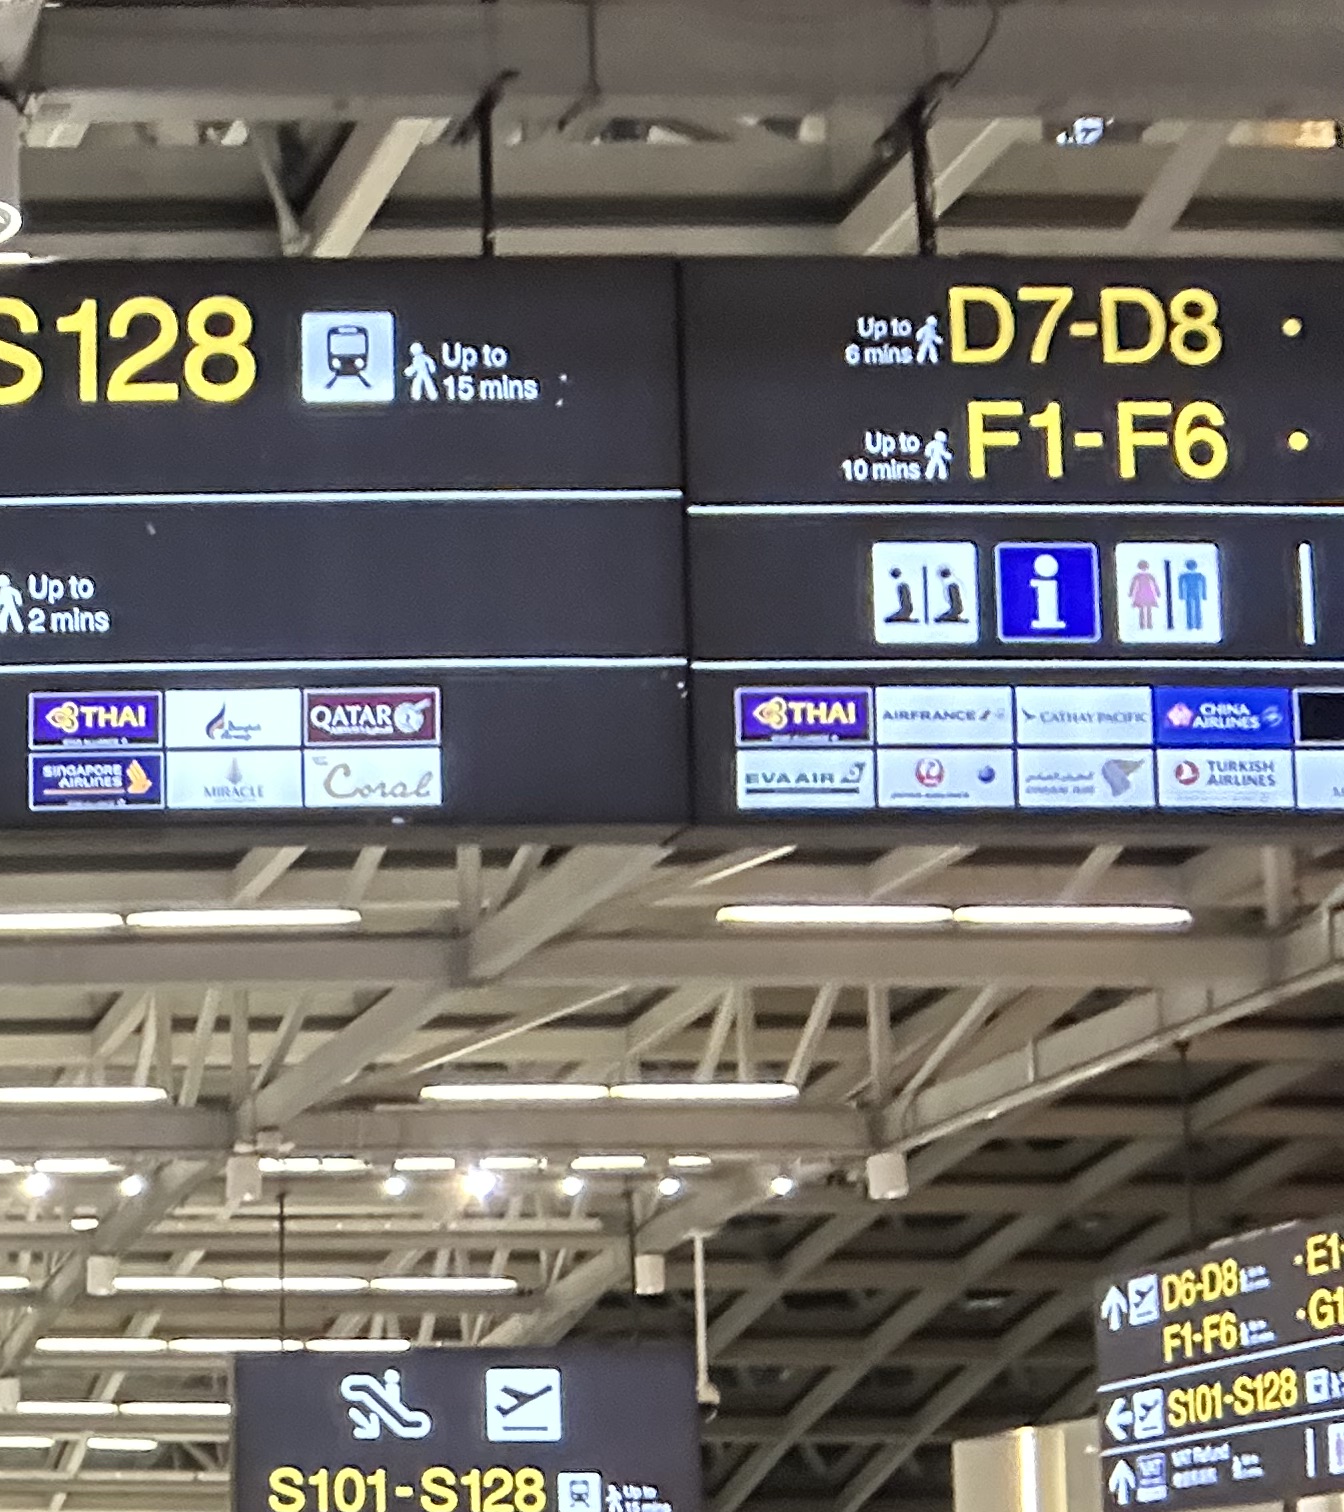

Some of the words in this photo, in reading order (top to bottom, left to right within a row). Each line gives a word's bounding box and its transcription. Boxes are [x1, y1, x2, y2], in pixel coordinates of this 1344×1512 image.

[857, 317, 888, 341] Up
[890, 318, 912, 337] to
[949, 286, 1222, 366] D7-D8
[442, 342, 478, 373] Up
[482, 345, 507, 368] to
[845, 343, 860, 365] 6
[864, 344, 913, 365] mins
[443, 375, 474, 401] 15
[478, 375, 538, 400] mins
[865, 431, 896, 457] Up
[898, 432, 922, 454] to
[967, 401, 1228, 479] F1-F6
[842, 459, 868, 481] 10
[872, 459, 921, 480] mins
[29, 574, 64, 602] Up
[68, 576, 94, 599] to
[28, 608, 45, 633] 2
[50, 607, 109, 633] mins
[80, 705, 145, 727] THAI
[310, 705, 393, 729] QATAR
[789, 702, 855, 724] THAI
[883, 709, 976, 721] AIRFRANCE
[1040, 711, 1093, 723] CATHAY
[1098, 711, 1148, 722] PACIFIC
[1199, 703, 1250, 715] CHINA
[1193, 714, 1260, 729] AIRLINES
[43, 764, 122, 777] SINGAPORE
[1207, 760, 1276, 773] TURKISH
[58, 776, 122, 788] AIRLINES
[322, 762, 434, 800] Coral
[745, 772, 790, 784] EVA
[795, 772, 835, 783] AIR
[1206, 773, 1277, 787] AIRLINES
[204, 786, 264, 798] MIRACLE
[1162, 1258, 1238, 1313] D6-D8
[1163, 1311, 1239, 1363] F1-F6
[1167, 1367, 1298, 1428] S101-S128
